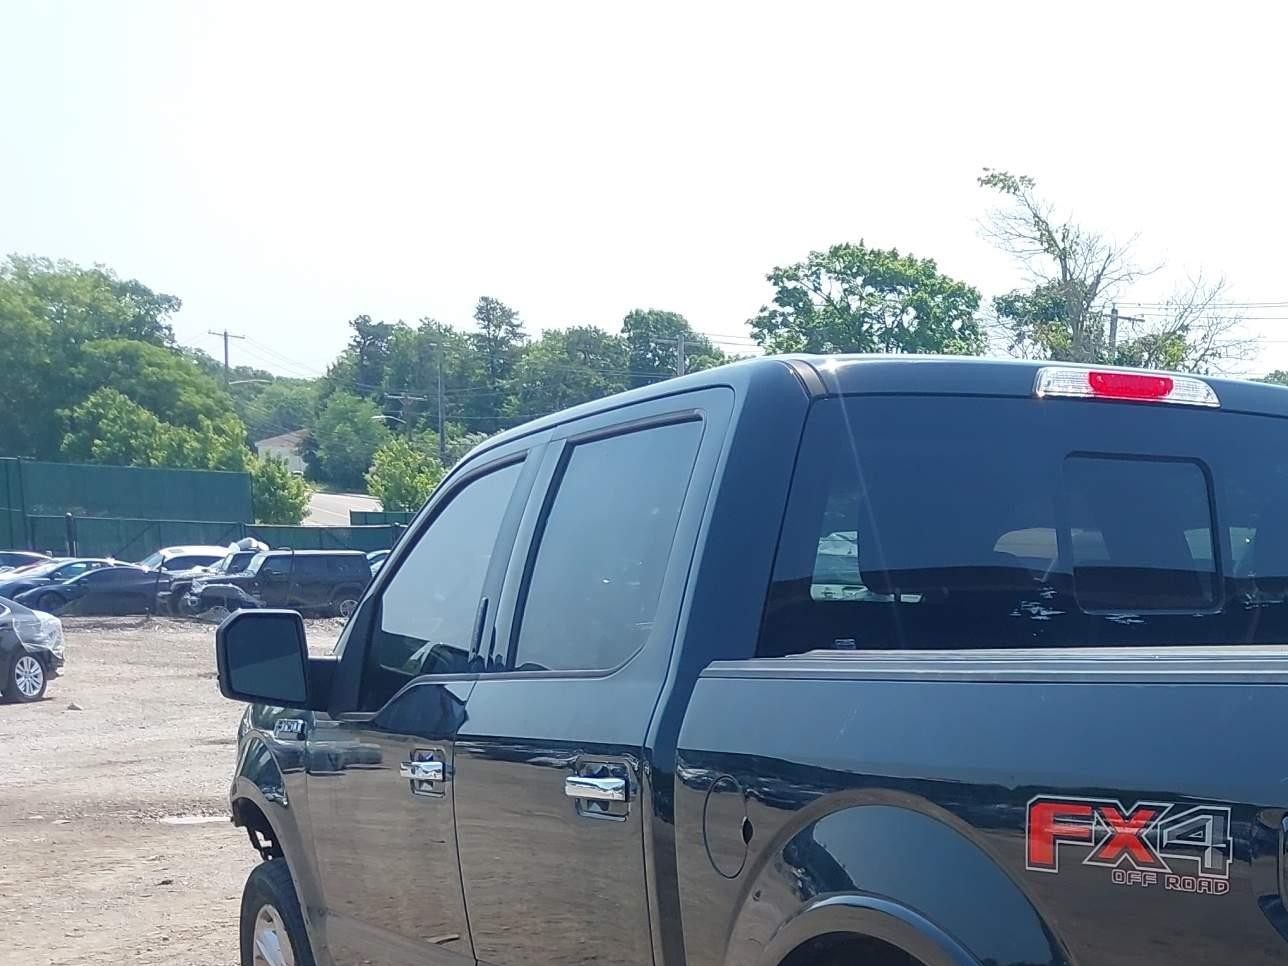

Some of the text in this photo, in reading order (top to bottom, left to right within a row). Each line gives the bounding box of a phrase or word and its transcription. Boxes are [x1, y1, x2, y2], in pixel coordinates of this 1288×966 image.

[1025, 794, 1233, 879] FX4
[1112, 869, 1230, 895] OFF ROAD
